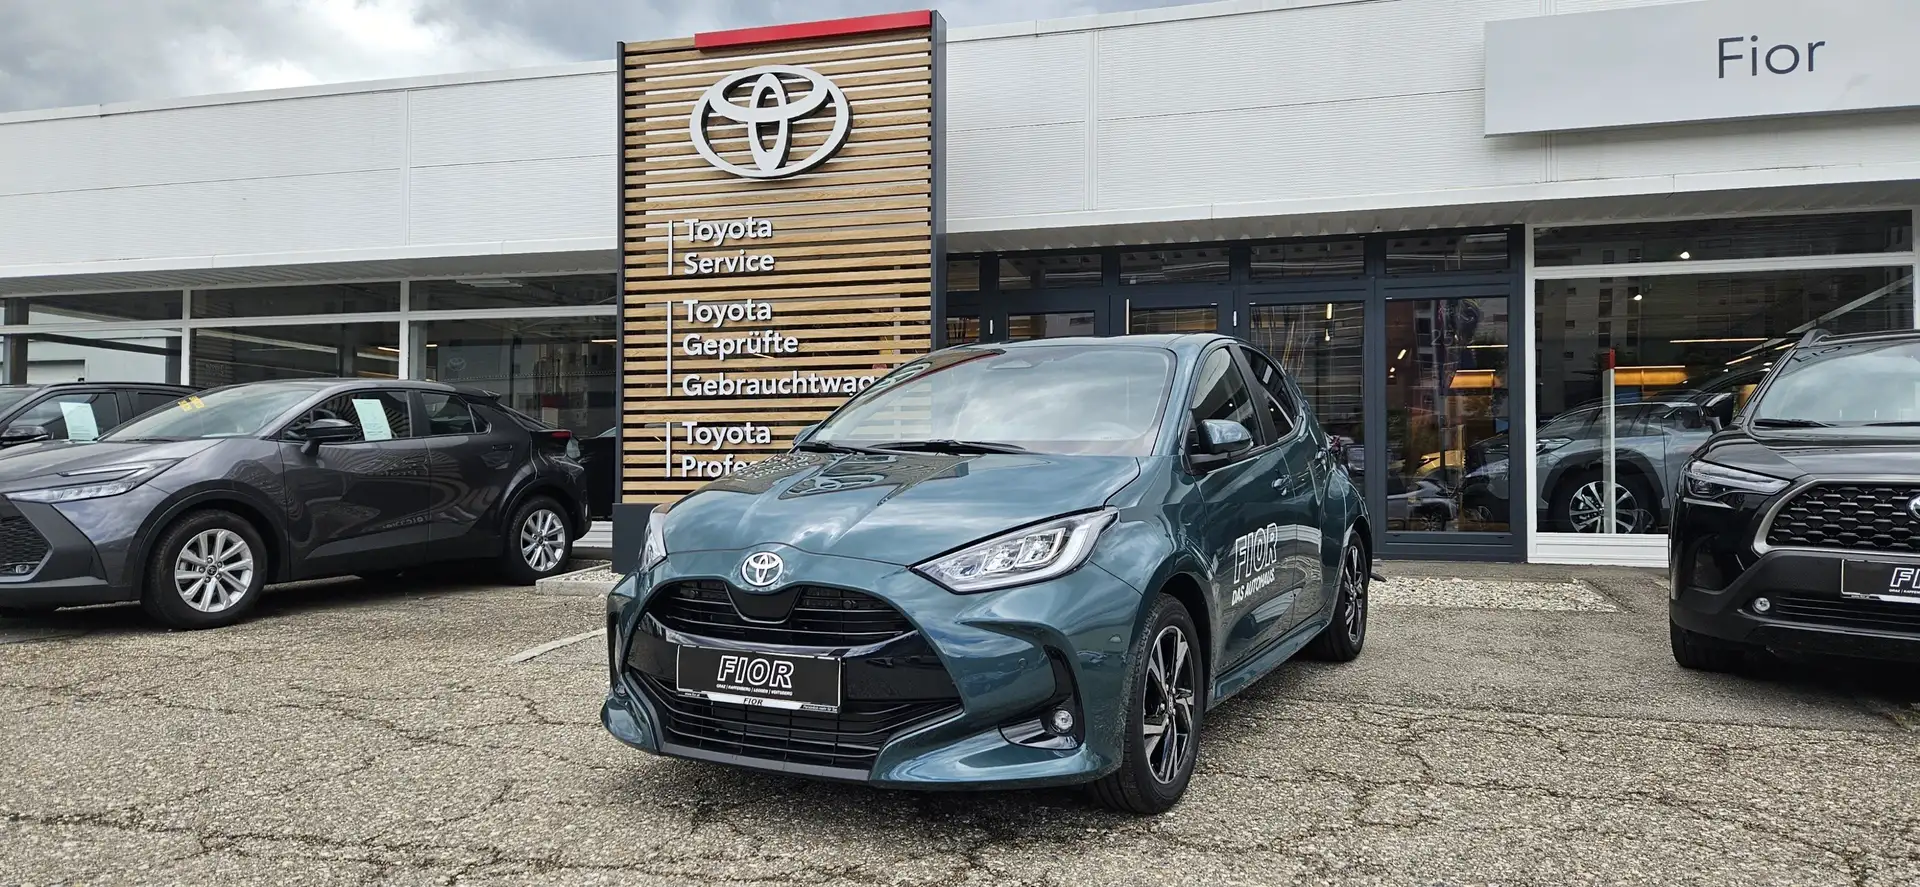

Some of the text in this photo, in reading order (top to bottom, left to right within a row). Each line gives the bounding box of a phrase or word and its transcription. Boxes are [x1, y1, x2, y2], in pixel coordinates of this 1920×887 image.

[1718, 35, 1826, 79] Fior
[683, 216, 773, 247] Toyota
[683, 249, 775, 275] Service
[682, 298, 773, 328] Toyota
[682, 330, 799, 360] Geprüfte
[681, 421, 772, 451] Toyota
[1233, 522, 1278, 584] FIOR
[1231, 568, 1275, 606] DAS AUTOHAUS
[717, 655, 794, 688] FIOR
[743, 697, 764, 706] FIOR
